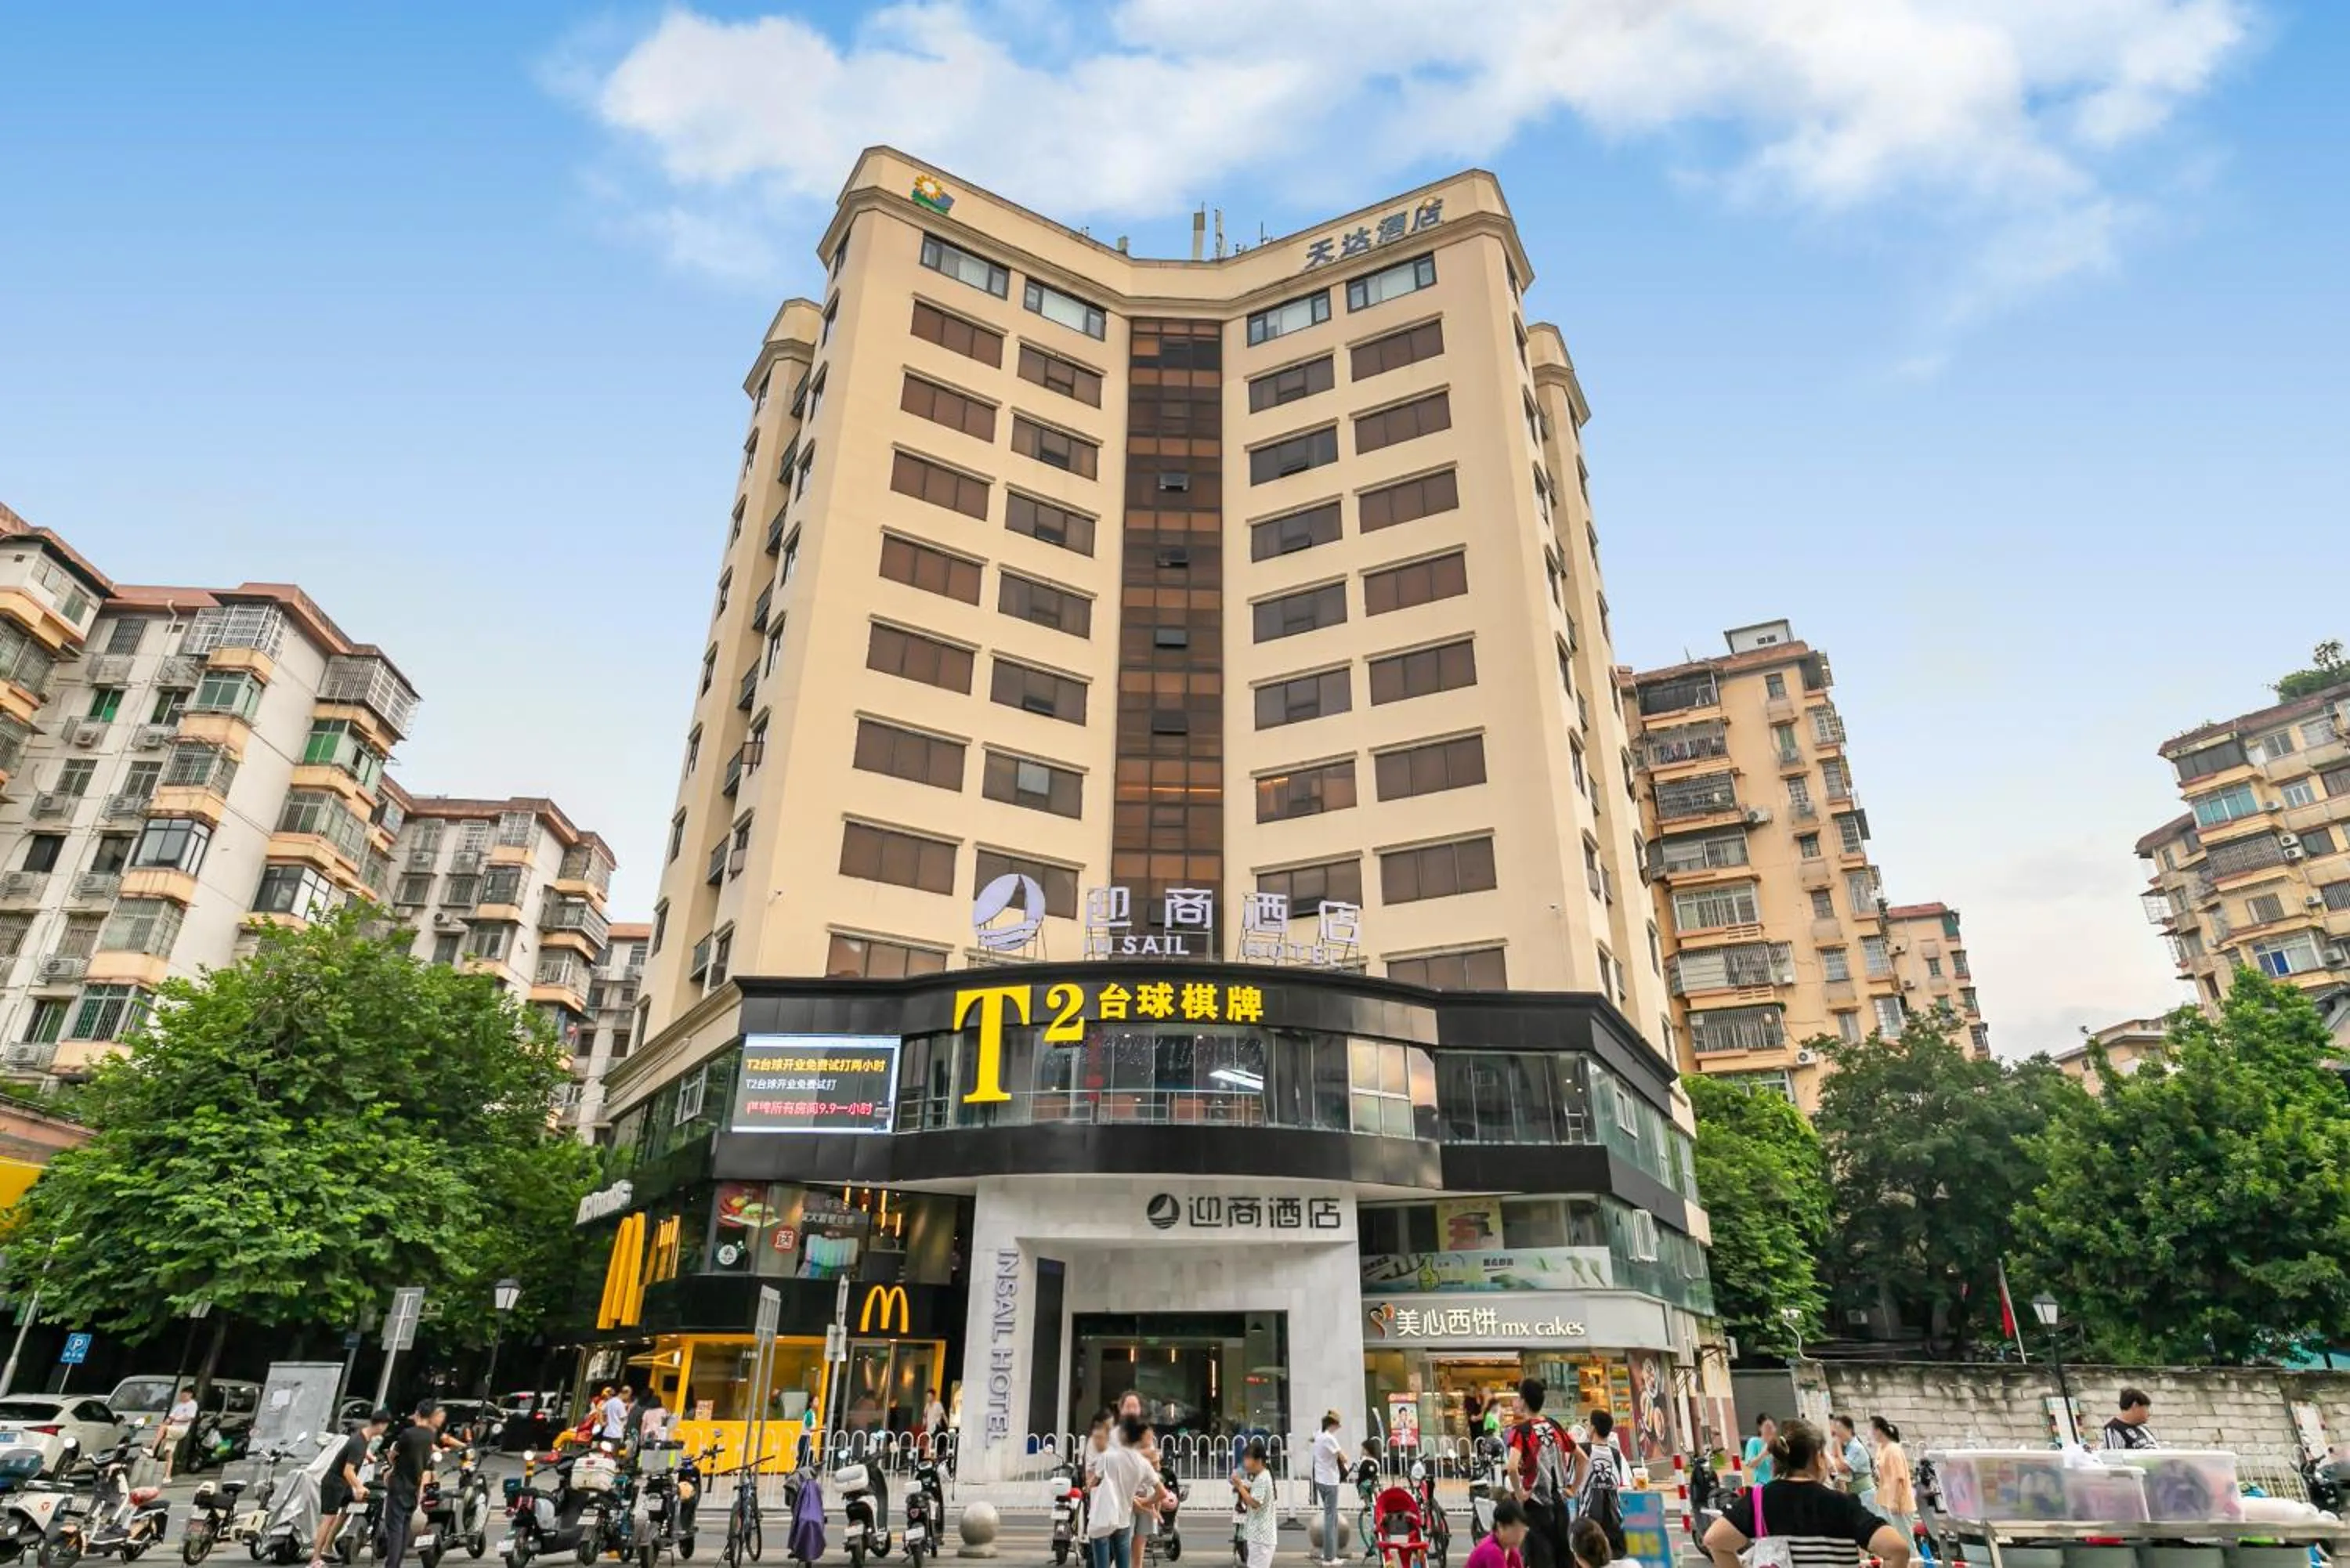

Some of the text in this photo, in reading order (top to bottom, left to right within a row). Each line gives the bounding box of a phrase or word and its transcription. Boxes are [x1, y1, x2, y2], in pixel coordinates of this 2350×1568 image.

[1086, 886, 1361, 945] 迎商酒店
[1098, 981, 1264, 1023] 台球棋牌
[1188, 1196, 1341, 1229] 迎商酒店
[1396, 1307, 1585, 1337] 美心西饼 mx cakes
[984, 1248, 1020, 1451] INSAIL HOTEL
